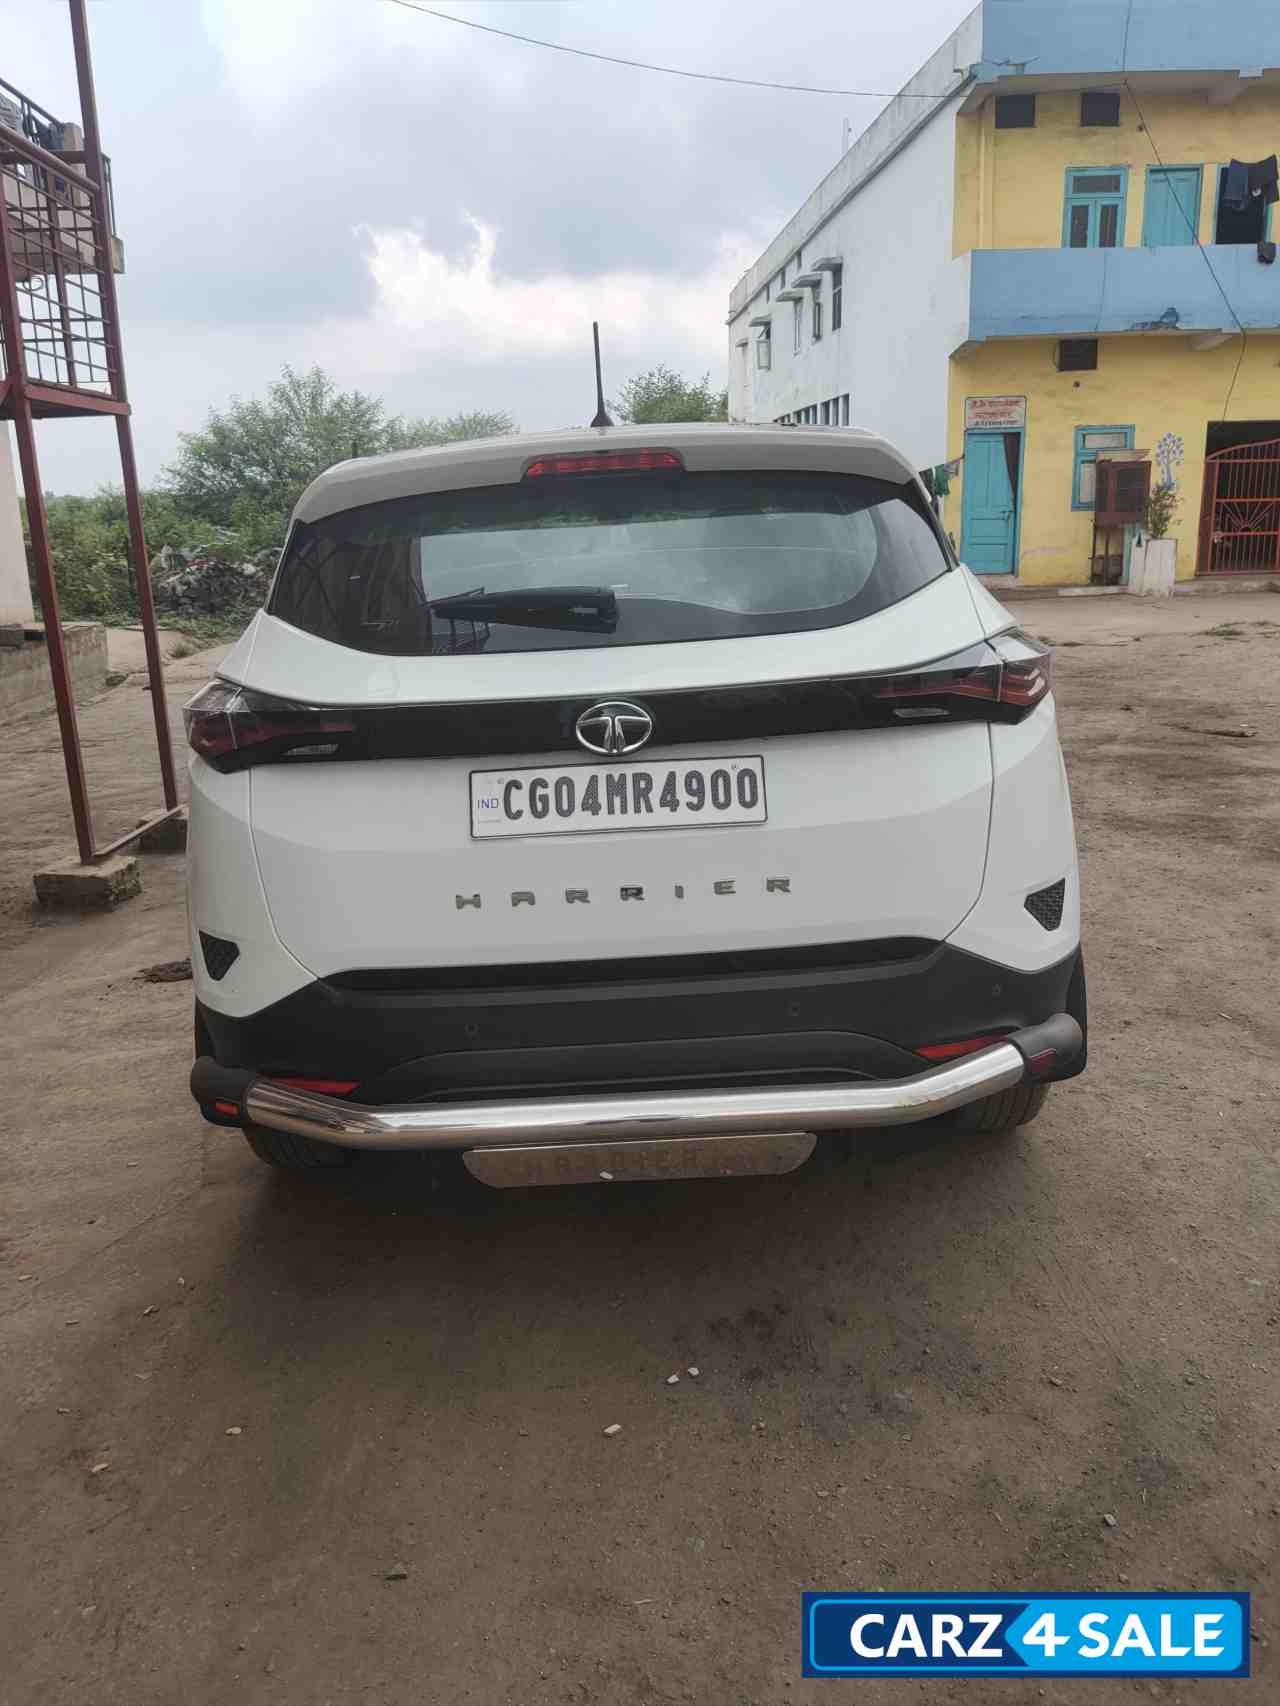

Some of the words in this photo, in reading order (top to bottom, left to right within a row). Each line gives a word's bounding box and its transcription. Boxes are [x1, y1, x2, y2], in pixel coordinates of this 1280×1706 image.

[478, 798, 500, 809] IND
[503, 768, 758, 821] CG04MR4900
[455, 878, 791, 910] HARRIER
